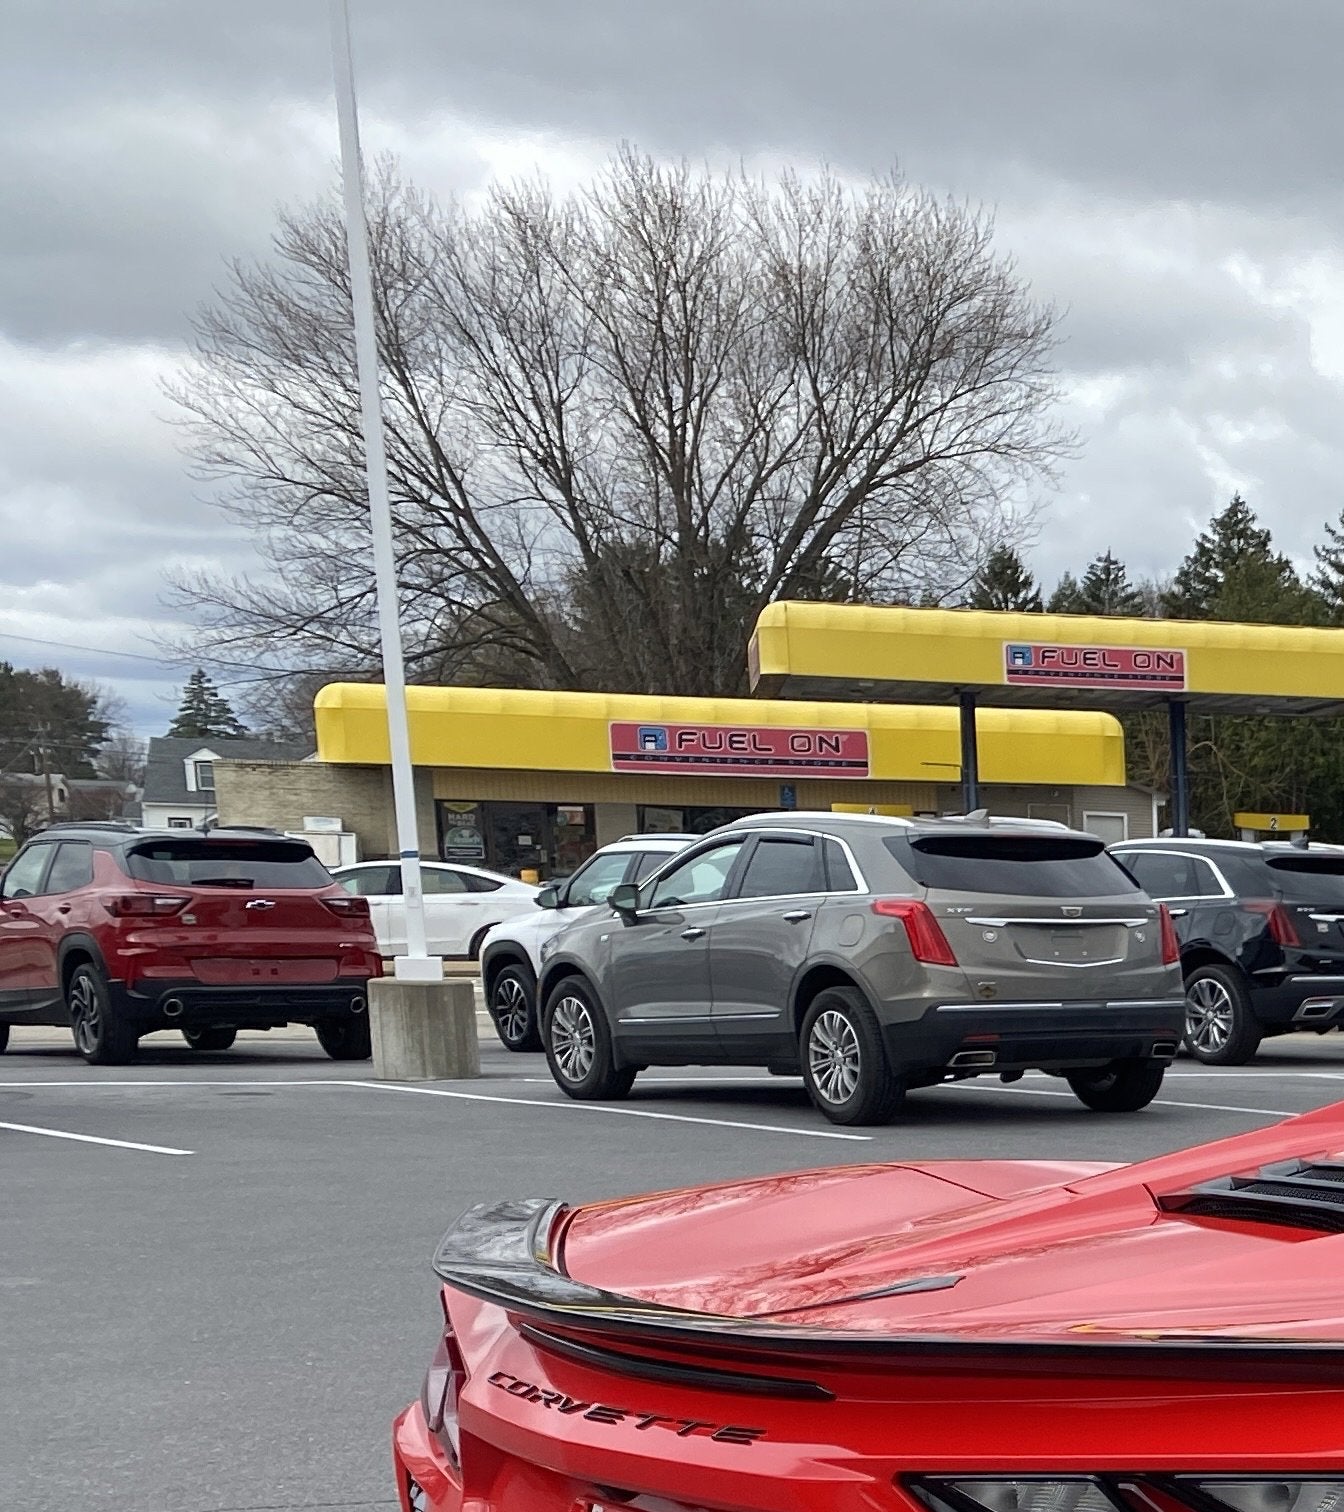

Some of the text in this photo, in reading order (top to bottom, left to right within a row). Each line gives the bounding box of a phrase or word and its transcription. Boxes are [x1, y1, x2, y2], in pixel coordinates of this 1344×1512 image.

[1040, 649, 1175, 671] FUEL ON
[675, 729, 842, 755] FUEL ON
[1270, 817, 1278, 830] 2
[488, 1371, 768, 1447] CORVETTE
